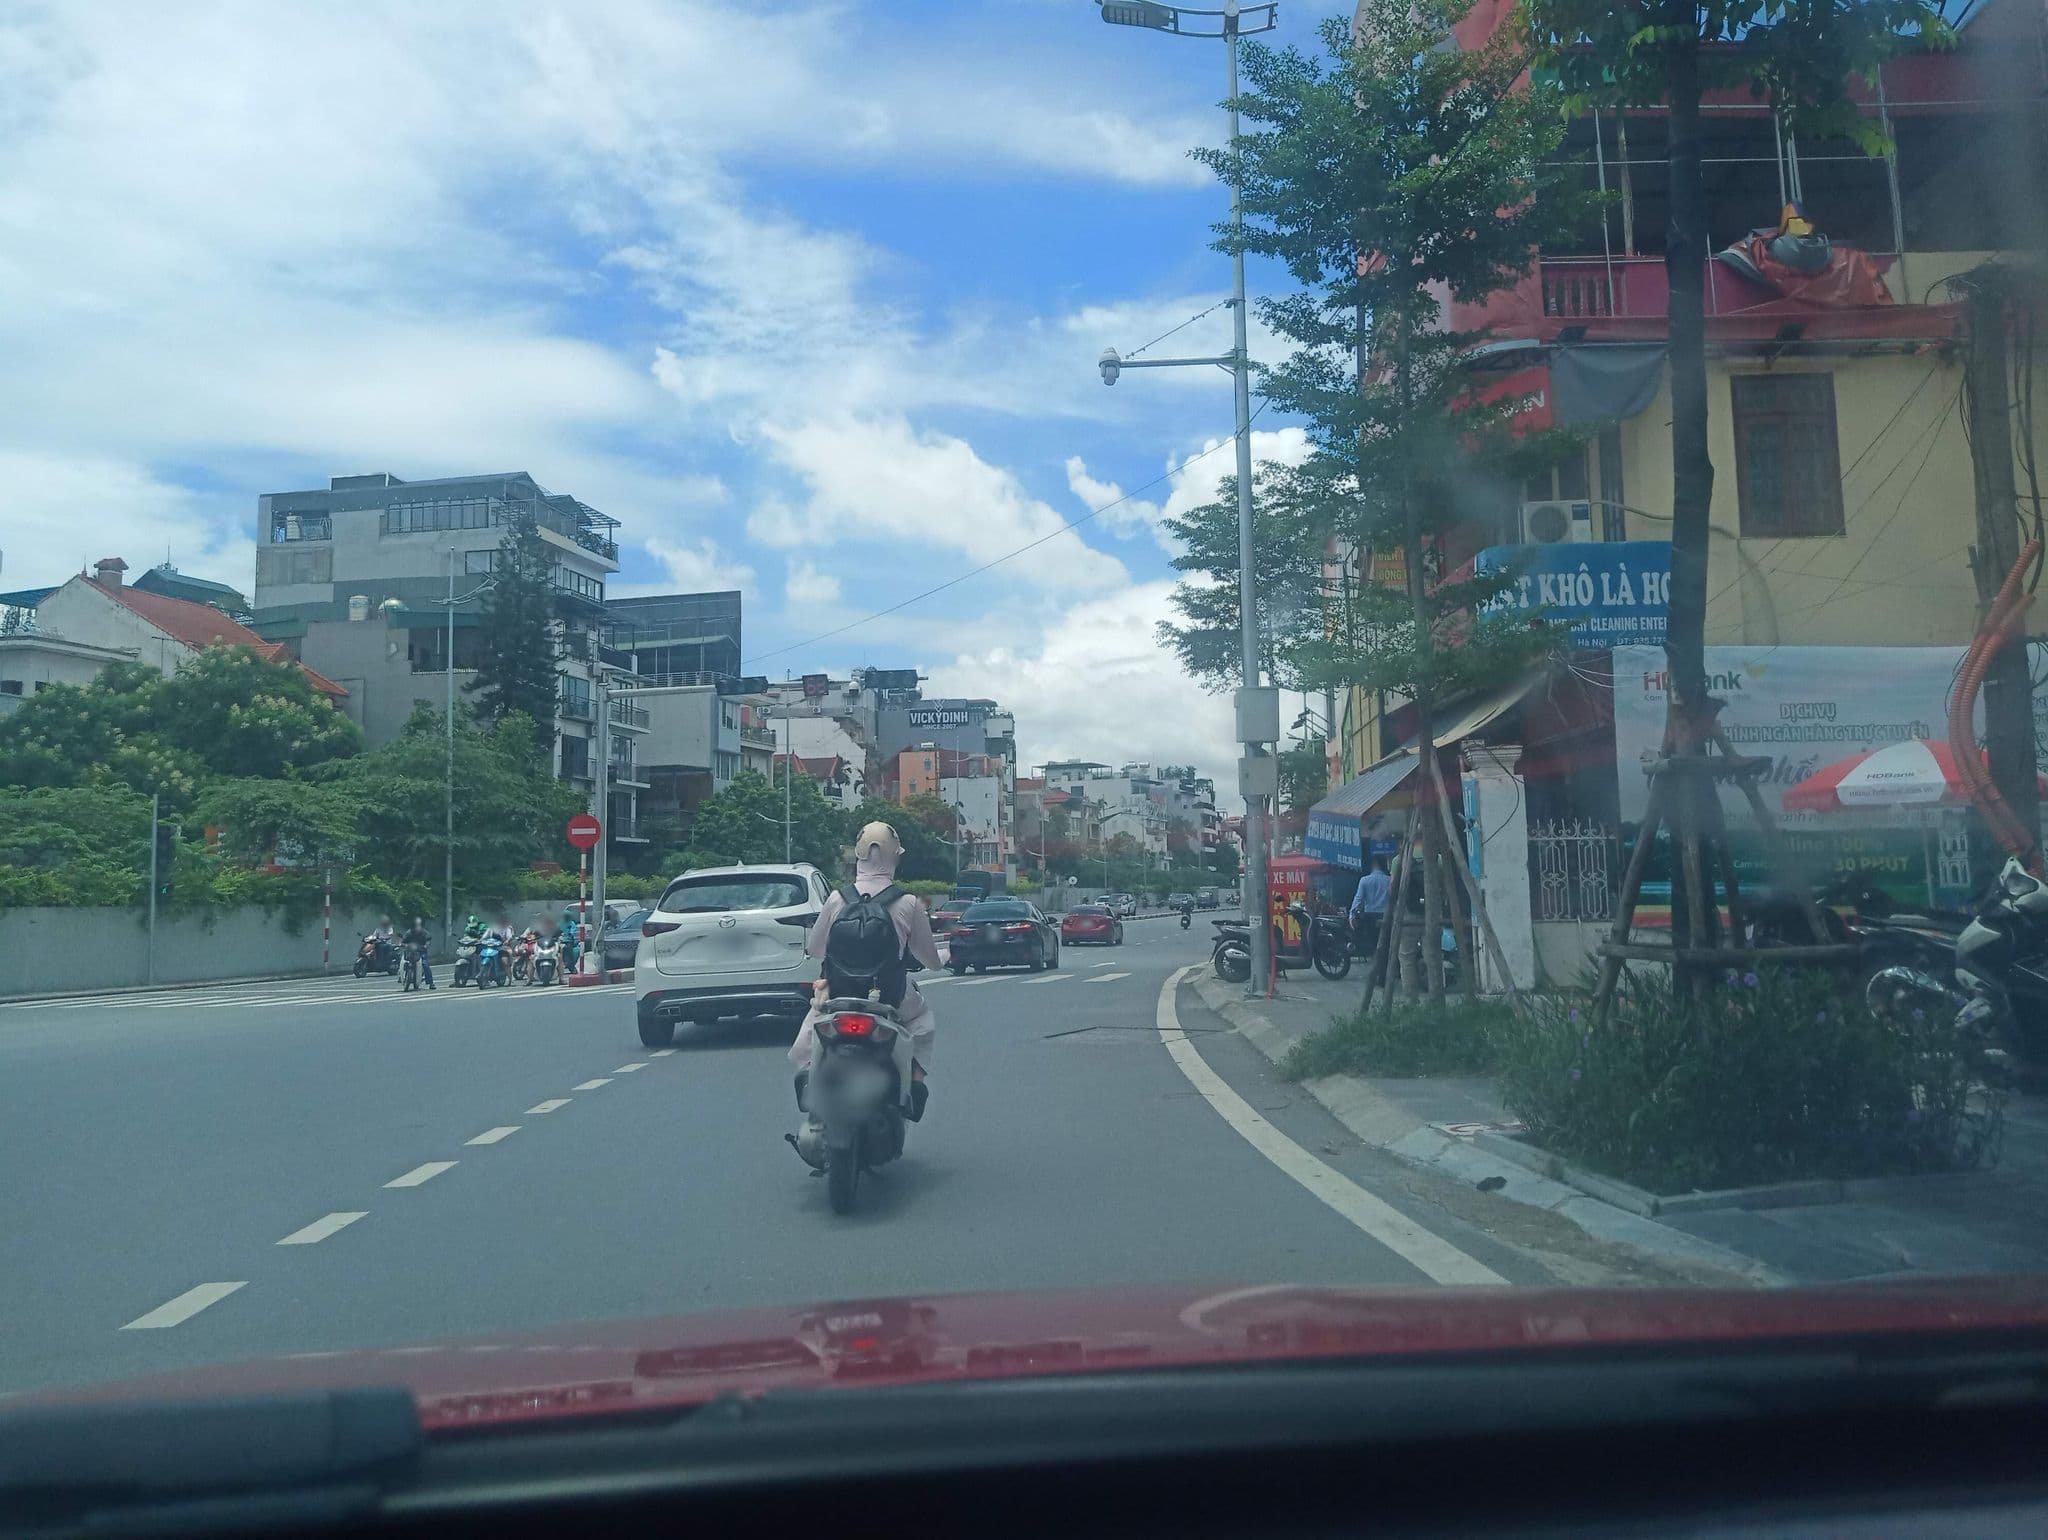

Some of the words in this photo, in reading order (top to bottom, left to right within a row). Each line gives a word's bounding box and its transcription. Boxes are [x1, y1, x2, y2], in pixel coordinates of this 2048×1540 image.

[1537, 562, 1595, 607] KHÔ
[1600, 562, 1637, 606] LÀ
[1590, 617, 1638, 632] CLEANING
[910, 711, 968, 724] VICKYDINH
[1780, 703, 1815, 722] DỊCH
[1816, 703, 1837, 721] VỤ
[1803, 724, 1845, 742] HÀNG
[1273, 871, 1285, 884] XE
[1286, 867, 1305, 884] MÁY
